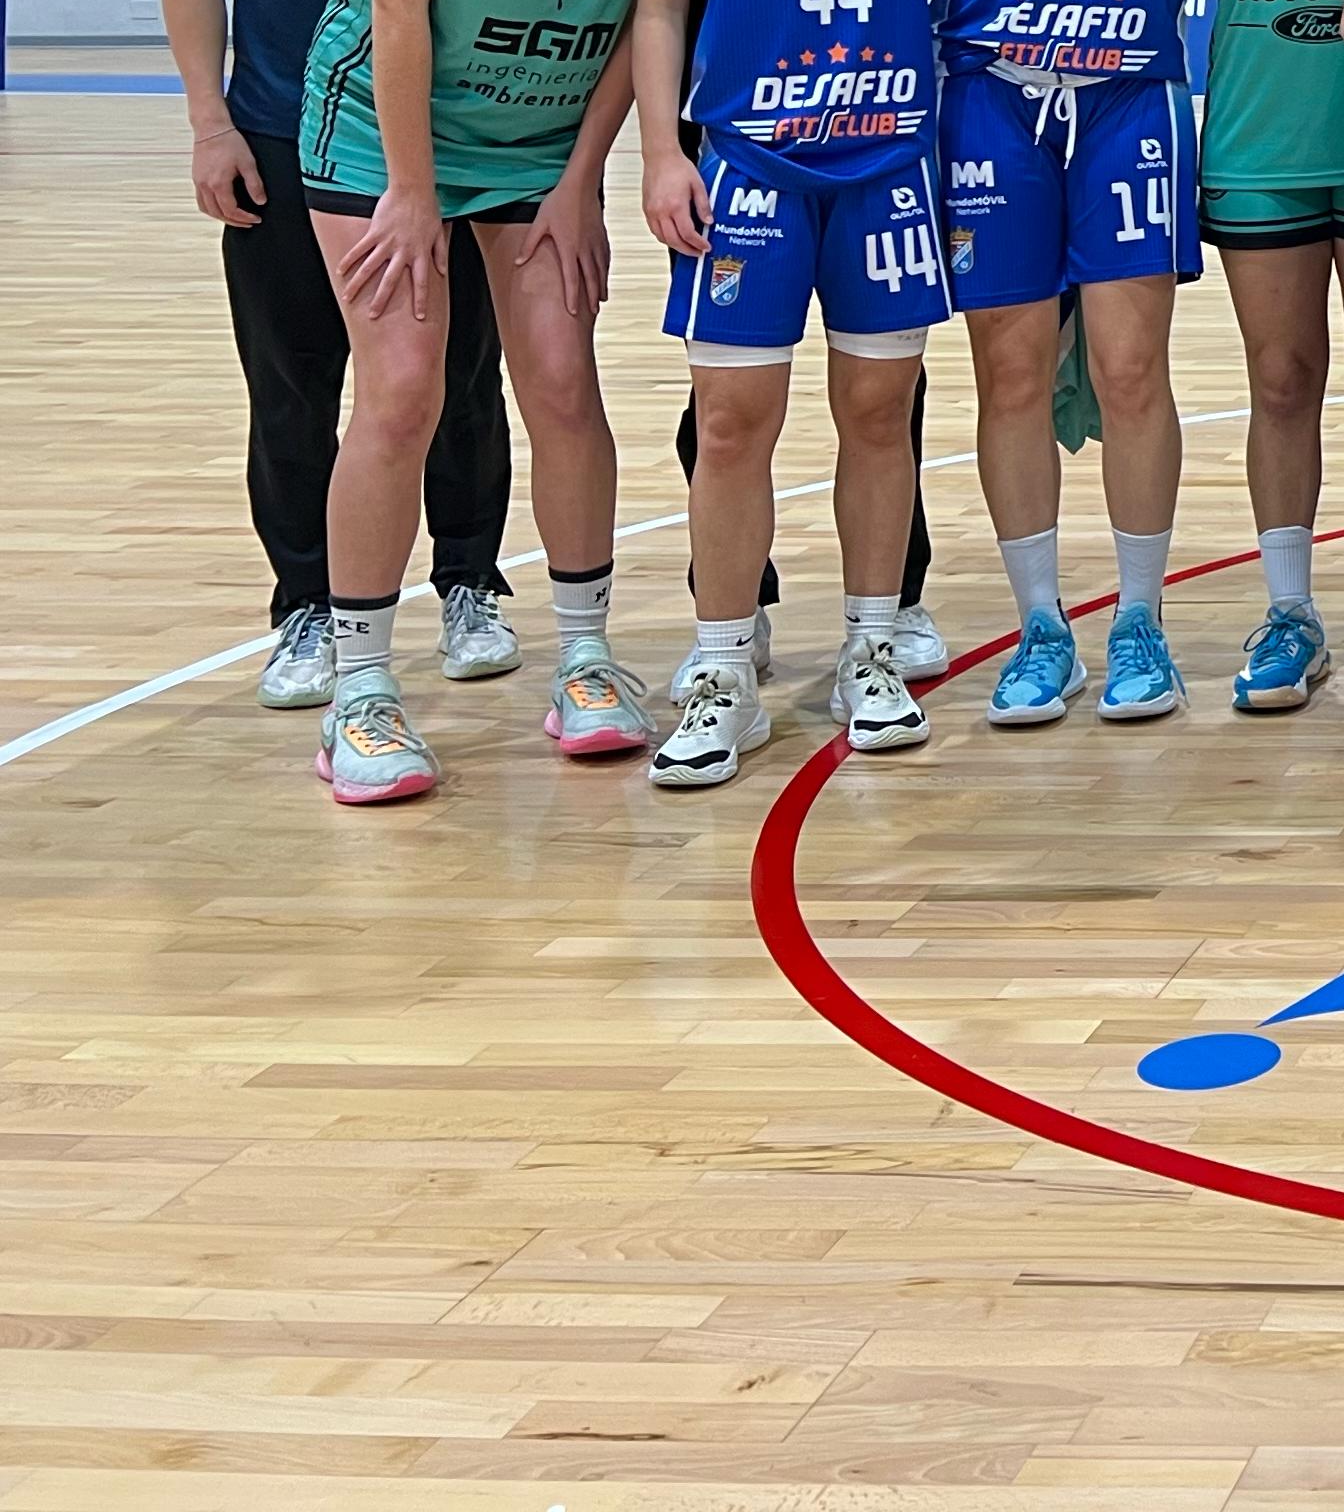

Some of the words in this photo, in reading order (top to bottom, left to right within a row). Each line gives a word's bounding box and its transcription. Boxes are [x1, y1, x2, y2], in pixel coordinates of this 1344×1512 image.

[473, 16, 618, 61] SGM
[1056, 46, 1122, 72] CLUB
[457, 78, 593, 107] ambiental
[752, 68, 917, 110] DESAFIO
[774, 115, 821, 141] FIT
[831, 112, 896, 137] CLUB
[1111, 177, 1172, 242] 14
[714, 223, 784, 239] MundoMÓVIL
[729, 235, 766, 247] Network
[865, 223, 938, 293] 44
[337, 619, 370, 634] KE
